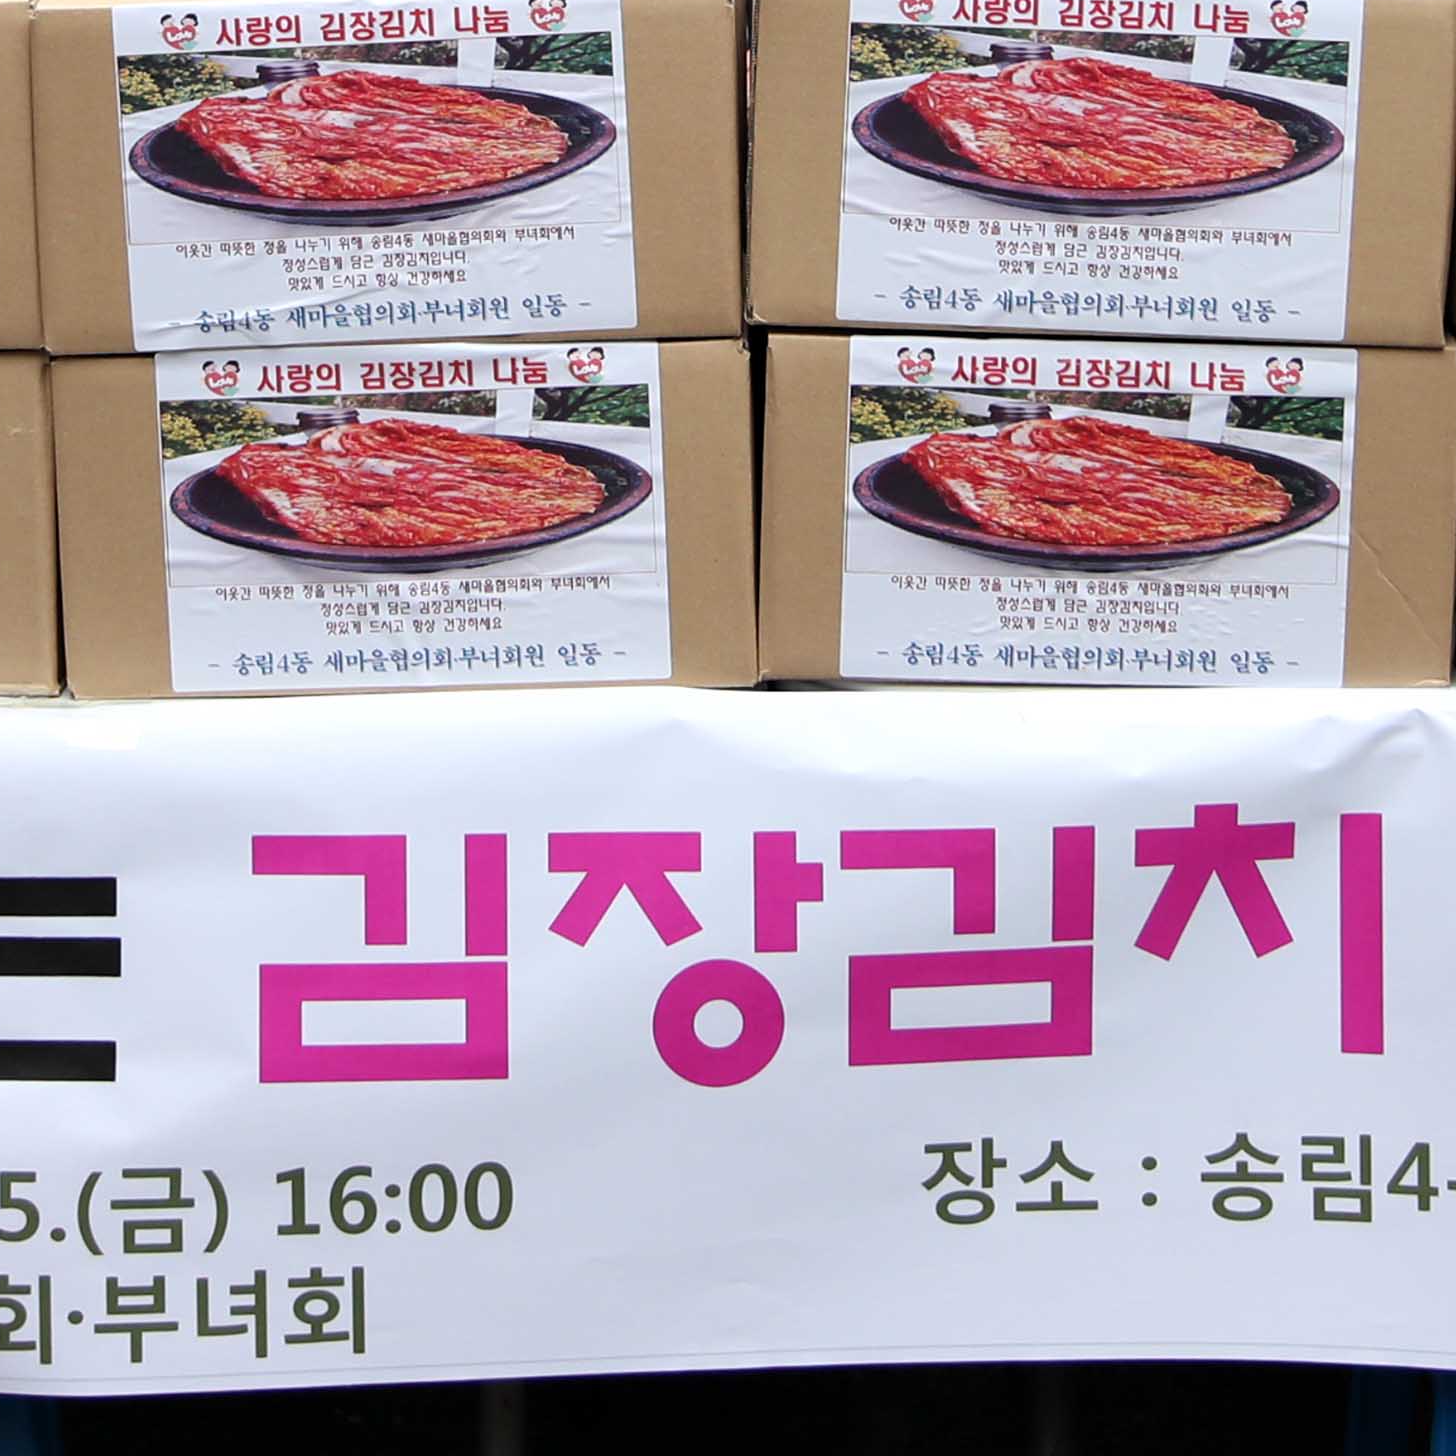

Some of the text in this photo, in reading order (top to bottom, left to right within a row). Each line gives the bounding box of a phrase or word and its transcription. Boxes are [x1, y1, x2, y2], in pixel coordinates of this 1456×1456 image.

[216, 6, 509, 46] 사랑의 김장김치 나눔
[1059, 0, 1173, 30] 김장김치
[1194, 4, 1249, 33] 나눔
[523, 294, 566, 318] 일동
[900, 285, 982, 311] 송림4동
[1232, 299, 1276, 323] 일동
[258, 357, 547, 393] 사랑의 김장김치 나눔
[952, 356, 1245, 392] 사랑의 김장김치 나눔
[234, 652, 313, 675] 송림4동
[558, 643, 601, 666] 일동
[903, 642, 983, 666] 송림4동
[1231, 651, 1274, 674] 일동
[252, 804, 1384, 1087] 김장김치
[276, 1161, 513, 1236] 16:00
[922, 1137, 1099, 1224] 장소
